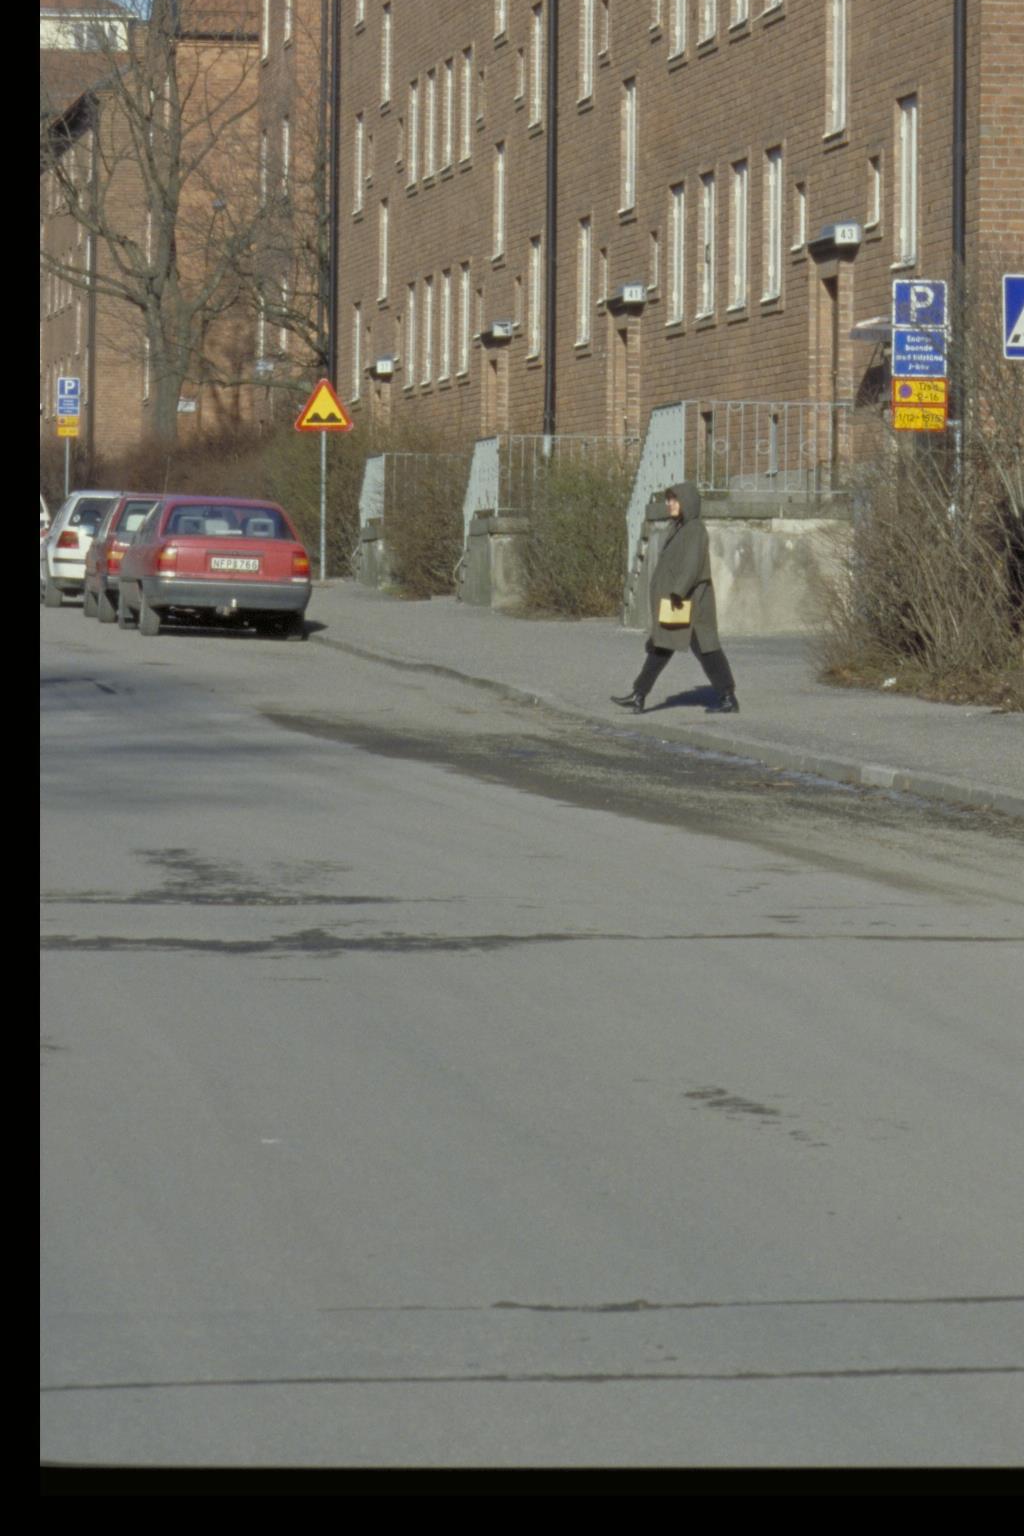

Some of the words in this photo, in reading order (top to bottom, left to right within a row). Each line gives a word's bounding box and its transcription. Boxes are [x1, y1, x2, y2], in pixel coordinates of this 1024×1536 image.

[840, 227, 854, 240] 43
[910, 285, 935, 322] P
[64, 380, 76, 395] P
